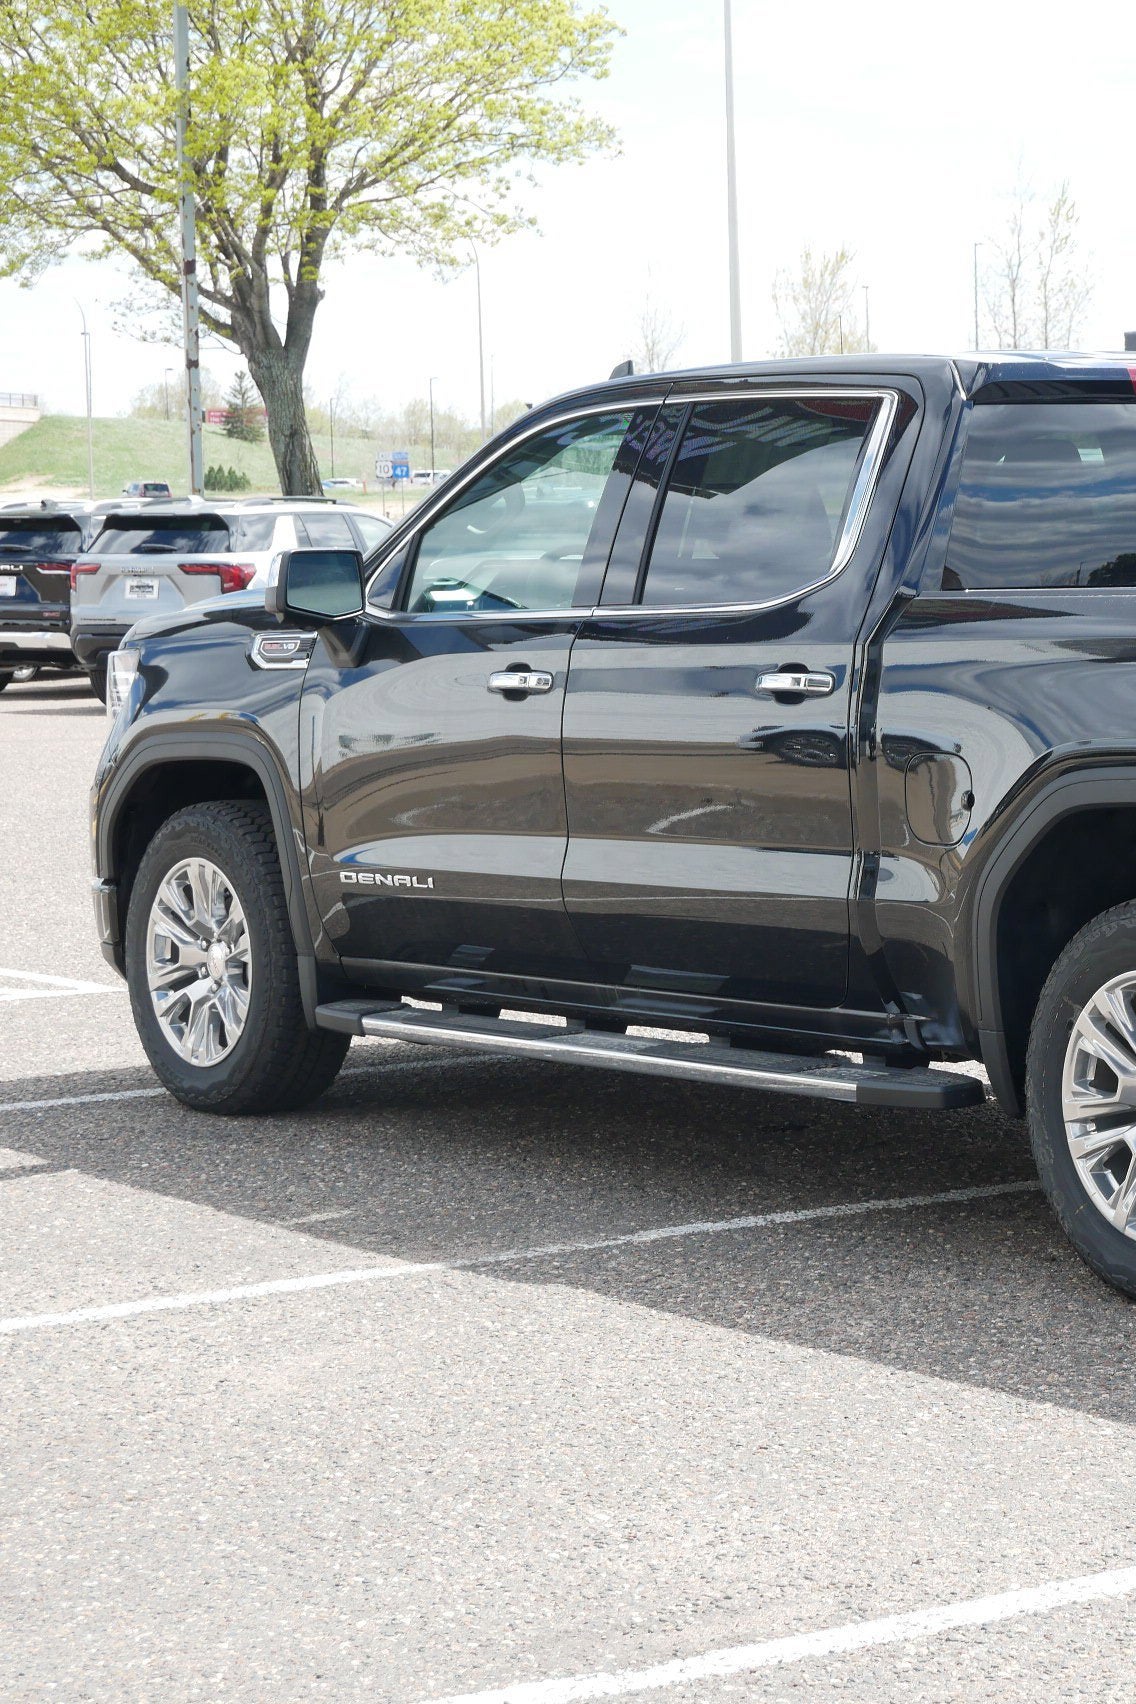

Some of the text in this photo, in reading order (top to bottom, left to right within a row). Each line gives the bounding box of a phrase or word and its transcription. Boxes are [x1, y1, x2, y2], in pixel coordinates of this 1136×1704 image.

[379, 465, 390, 474] 10
[395, 466, 407, 476] 47
[339, 871, 434, 889] DENALI
